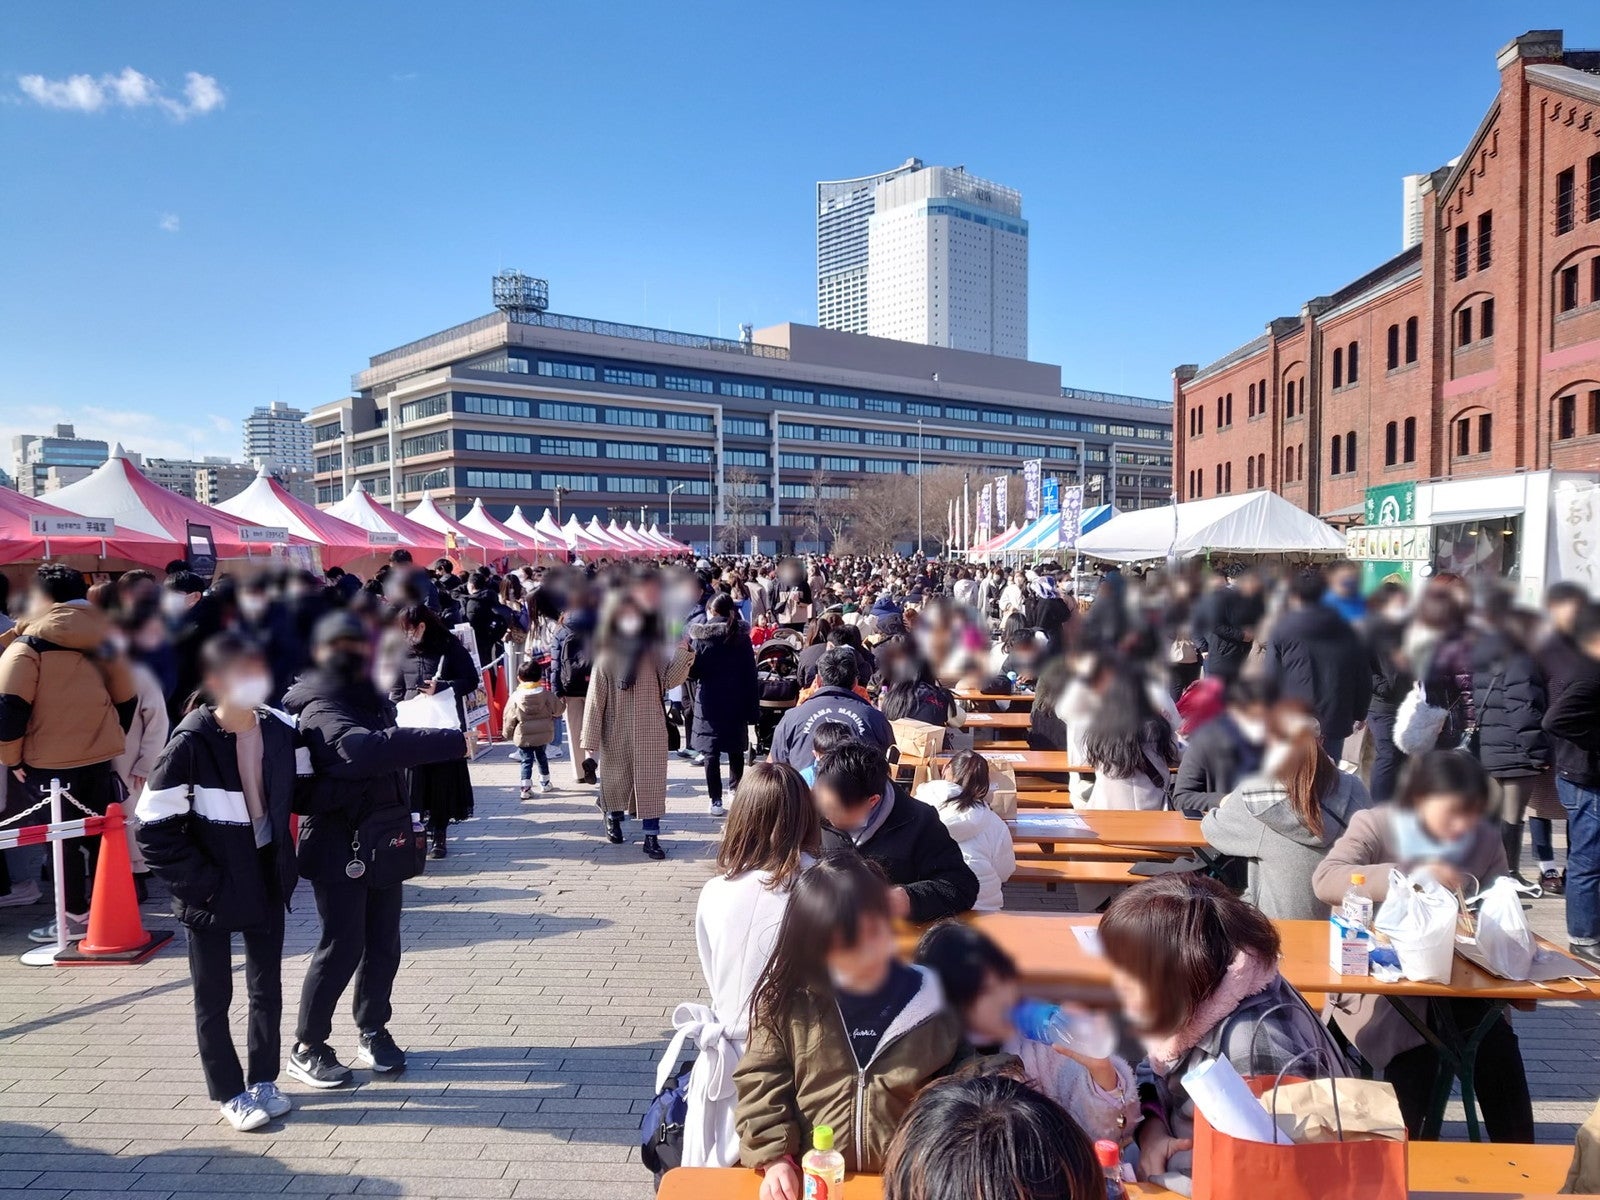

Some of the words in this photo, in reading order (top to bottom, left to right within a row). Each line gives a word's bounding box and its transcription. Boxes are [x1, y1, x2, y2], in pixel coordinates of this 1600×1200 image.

[34, 520, 47, 532] 14
[803, 708, 833, 734] HAYAMA
[837, 707, 866, 735] MARINA
